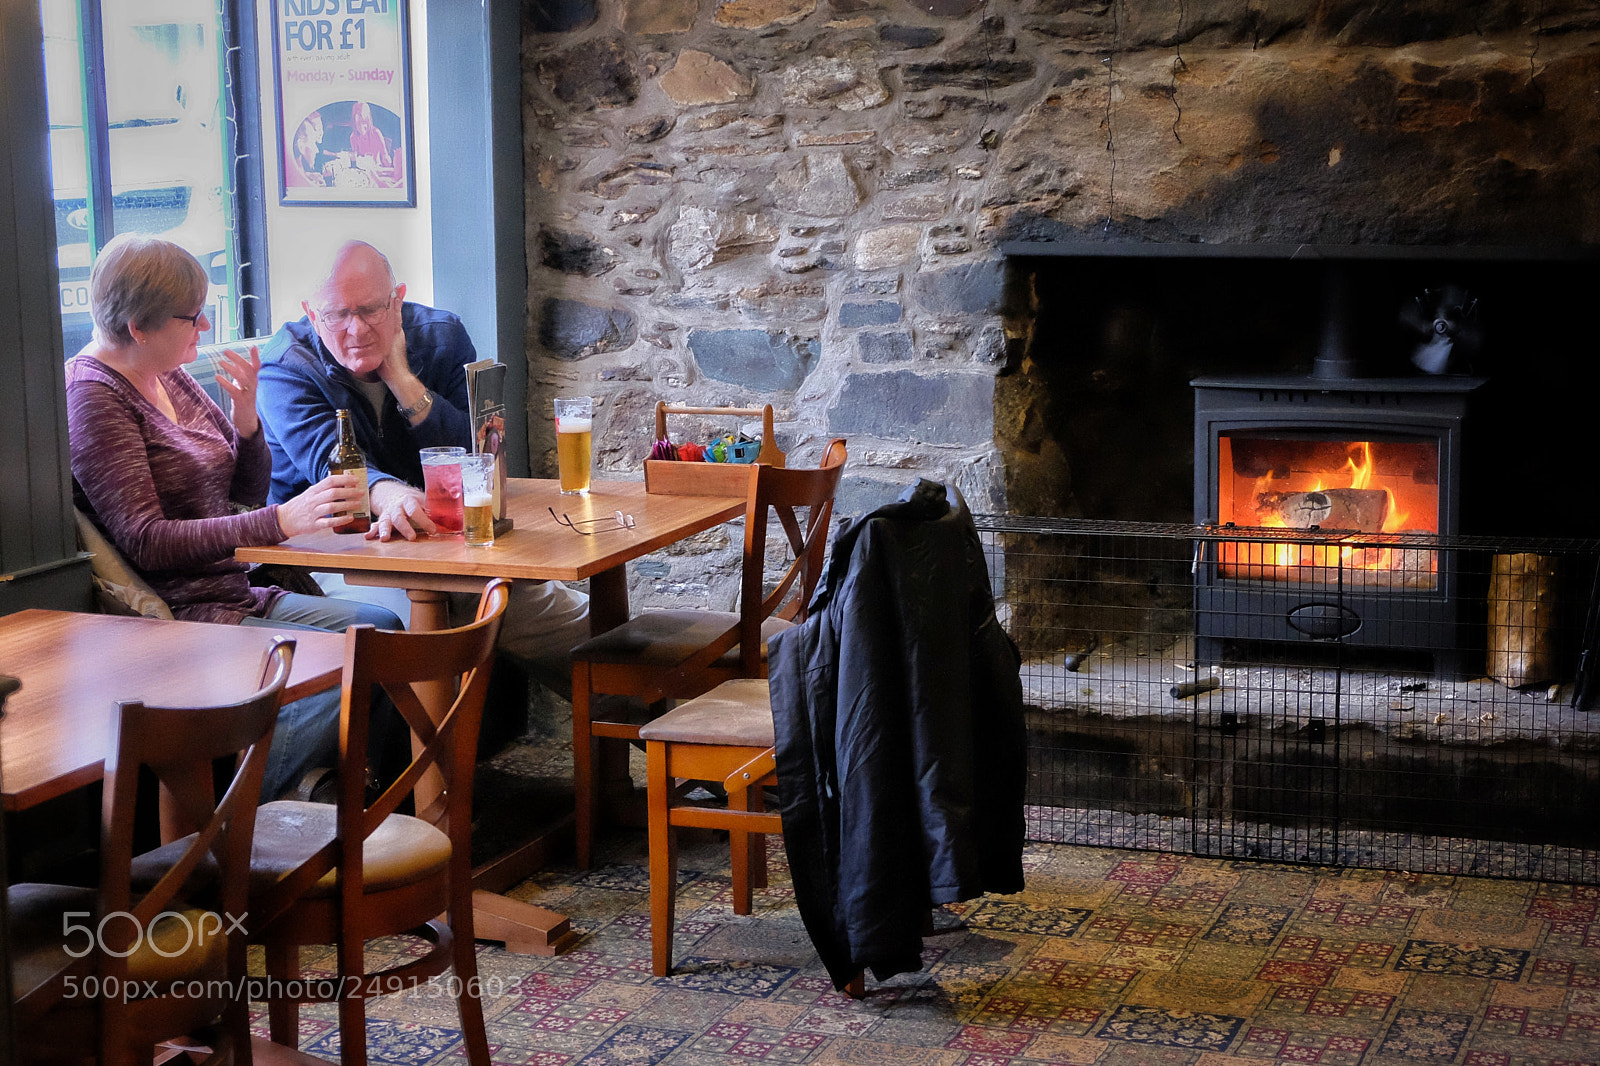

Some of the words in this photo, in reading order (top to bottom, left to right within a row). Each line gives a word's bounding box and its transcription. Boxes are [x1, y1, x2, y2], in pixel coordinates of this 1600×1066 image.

[284, 0, 340, 16] KIDS
[285, 20, 333, 51] FOR
[340, 18, 366, 49] £1
[287, 70, 335, 84] Monday
[348, 68, 394, 84] Sunday
